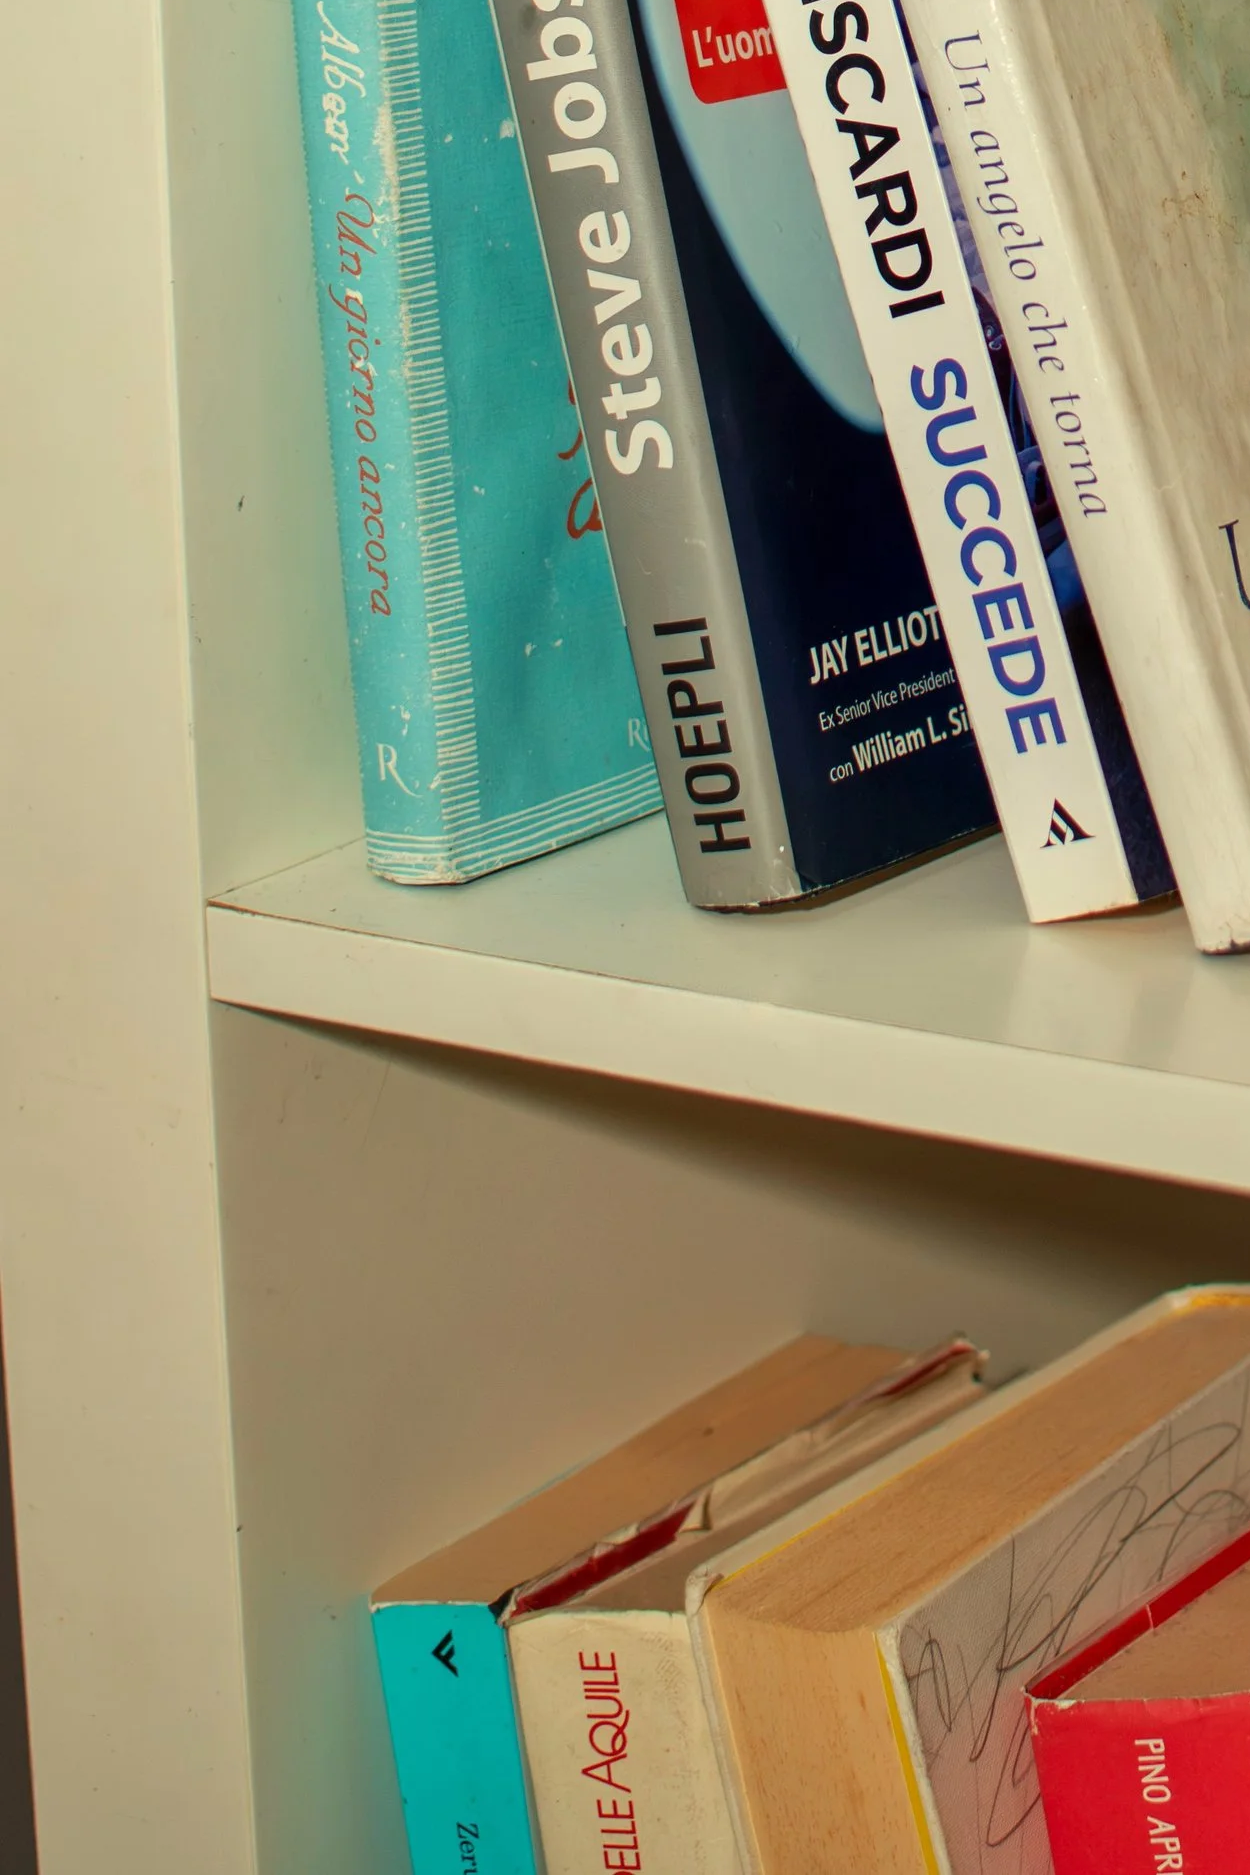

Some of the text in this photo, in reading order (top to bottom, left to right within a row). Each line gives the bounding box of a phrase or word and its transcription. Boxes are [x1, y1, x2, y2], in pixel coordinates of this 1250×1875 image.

[333, 191, 376, 284] Un
[943, 30, 991, 110] Un
[970, 128, 1044, 284] angelo
[1020, 299, 1068, 375] che
[1049, 389, 1109, 521] torna
[328, 284, 380, 443] giorno
[577, 209, 675, 477] Steve
[353, 455, 395, 619] ancora
[910, 356, 1068, 755] SUCCEDE
[653, 617, 753, 854] HOEPLI
[809, 635, 849, 685] JAY
[818, 667, 956, 732] Ex Senior Vice President
[829, 760, 854, 784] con
[851, 726, 926, 773] William
[926, 716, 948, 745] L.
[577, 1649, 642, 1875] ELLE AQUILE
[1134, 1738, 1172, 1803] PINO
